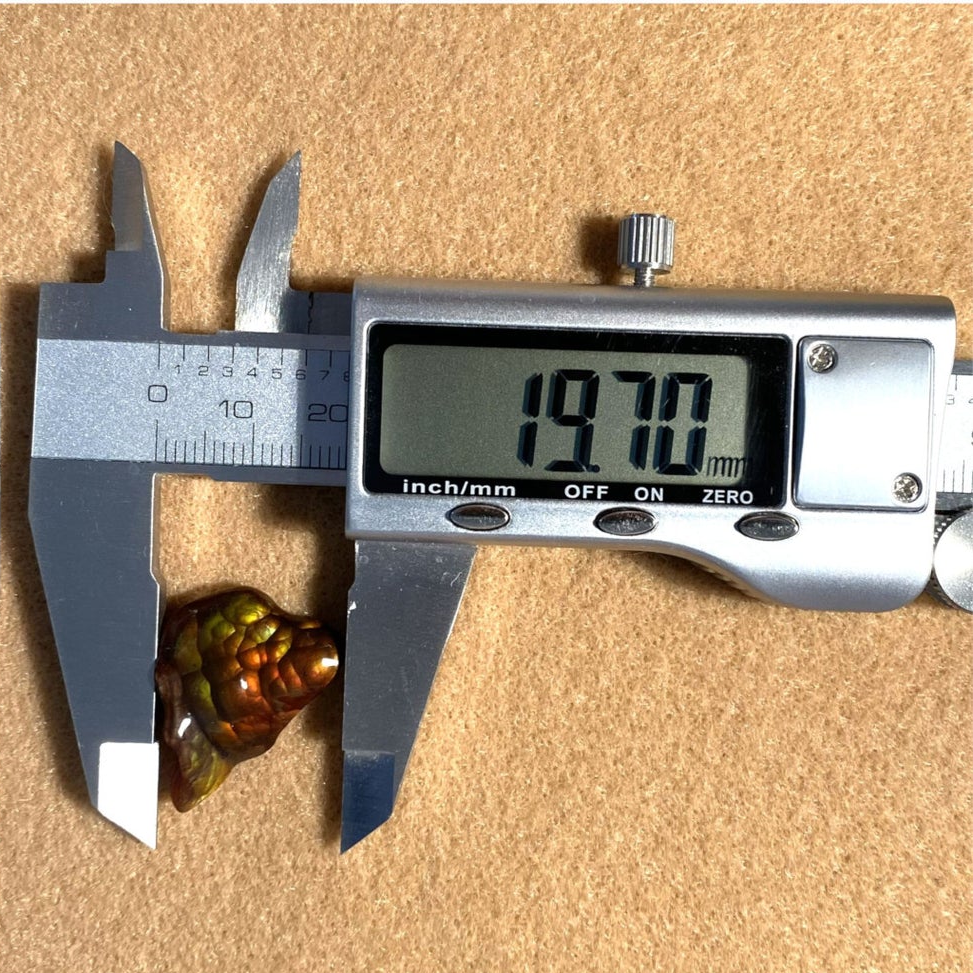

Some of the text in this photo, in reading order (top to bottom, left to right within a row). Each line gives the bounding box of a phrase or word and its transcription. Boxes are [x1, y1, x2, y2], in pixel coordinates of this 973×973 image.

[175, 365, 329, 380] 1 2 3 4 5 6 7
[148, 384, 348, 422] 0 10 20
[517, 370, 712, 475] 19.70
[402, 479, 753, 505] inch/mm OFF ON ZERO
